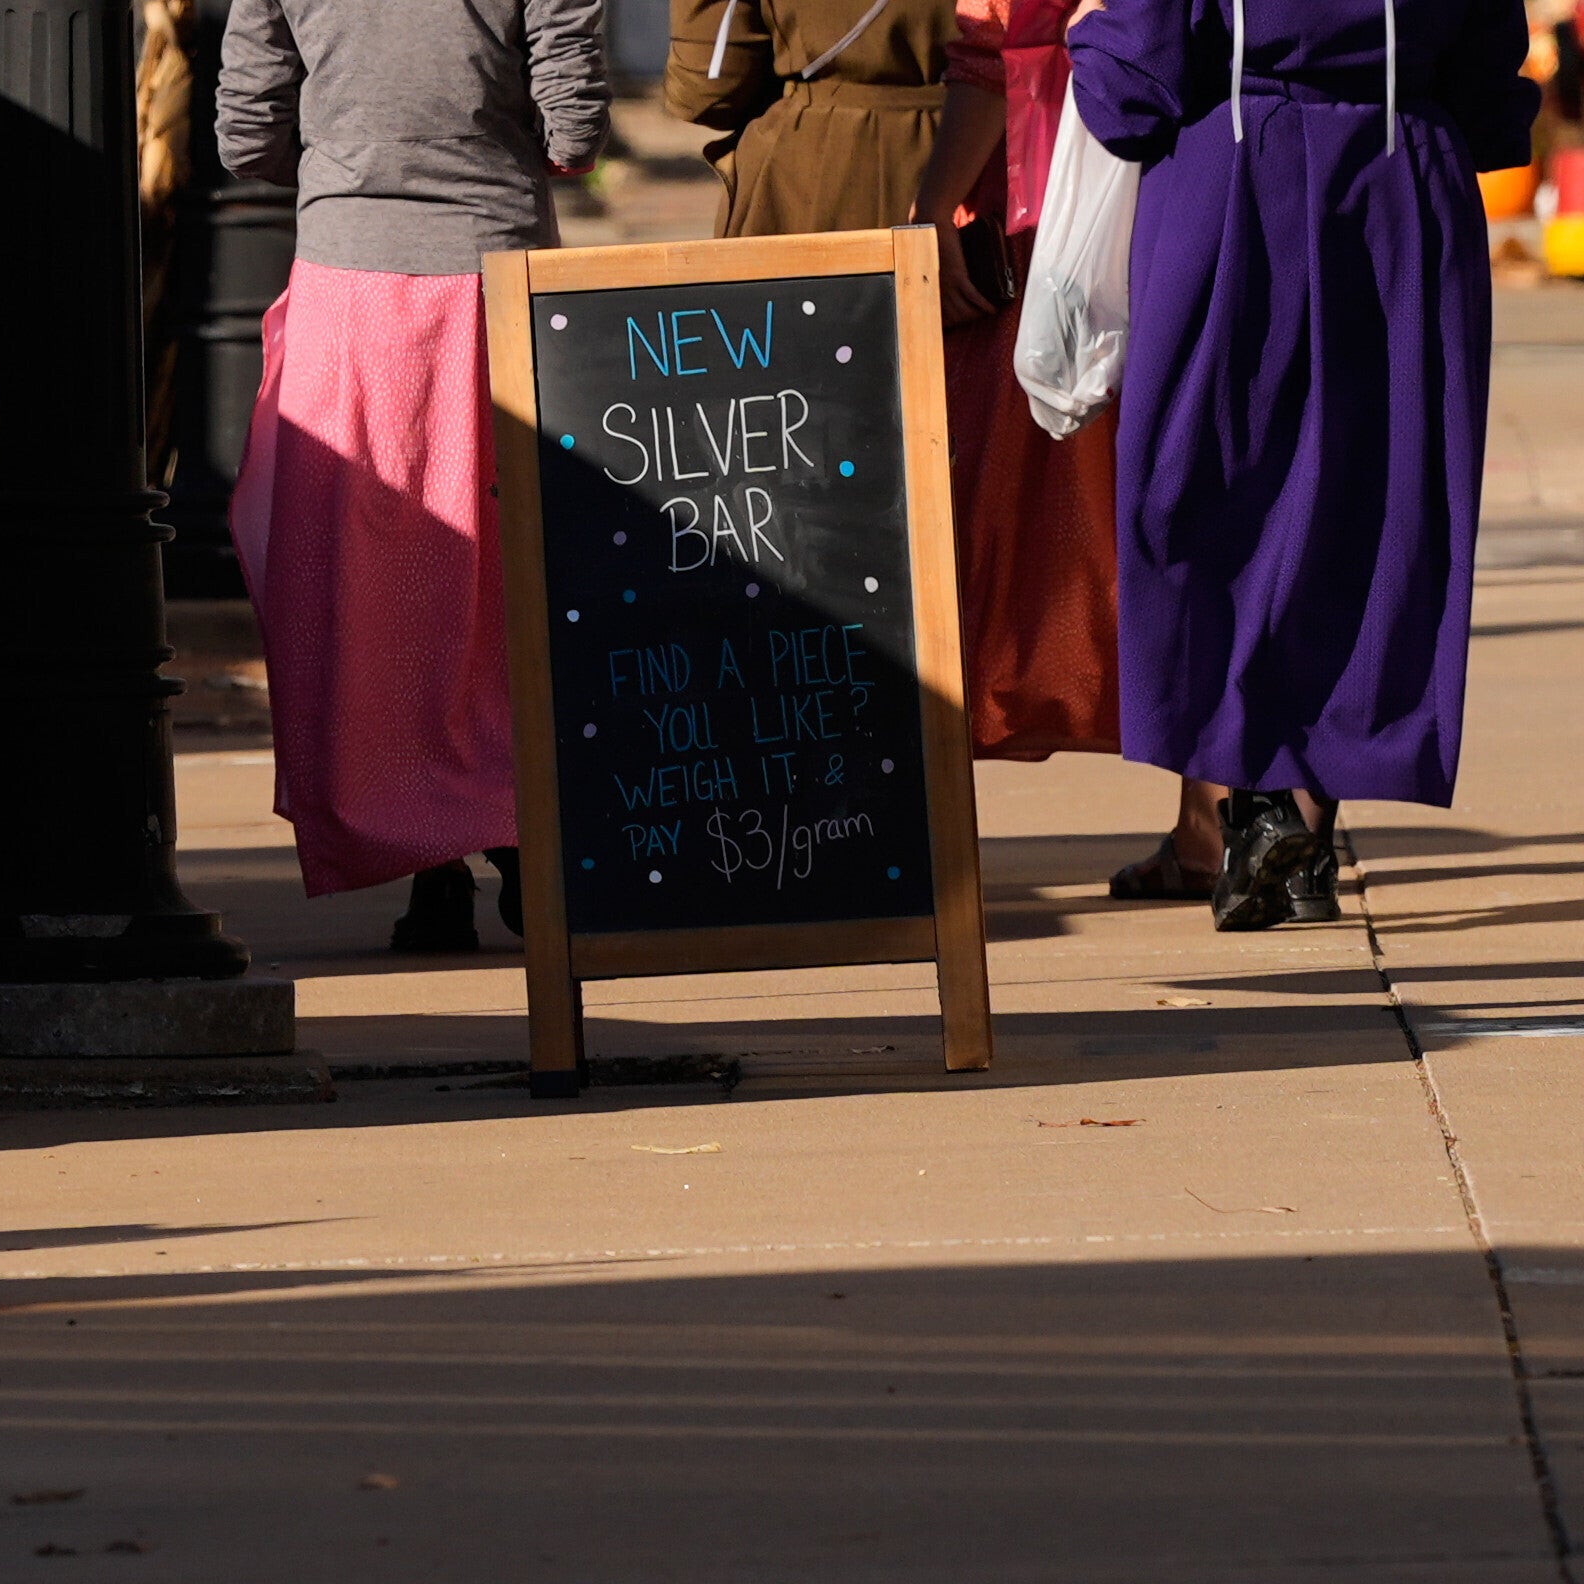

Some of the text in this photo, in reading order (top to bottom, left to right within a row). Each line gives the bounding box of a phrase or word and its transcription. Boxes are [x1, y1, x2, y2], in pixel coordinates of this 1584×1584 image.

[627, 301, 773, 380] NEW
[602, 389, 815, 485] SILVER
[660, 486, 784, 572] BAR
[609, 623, 875, 696] FIND A PIECE
[642, 702, 719, 754] YOU
[614, 752, 844, 811] WEIGH IT &
[622, 804, 874, 890] PAY $3/gram
